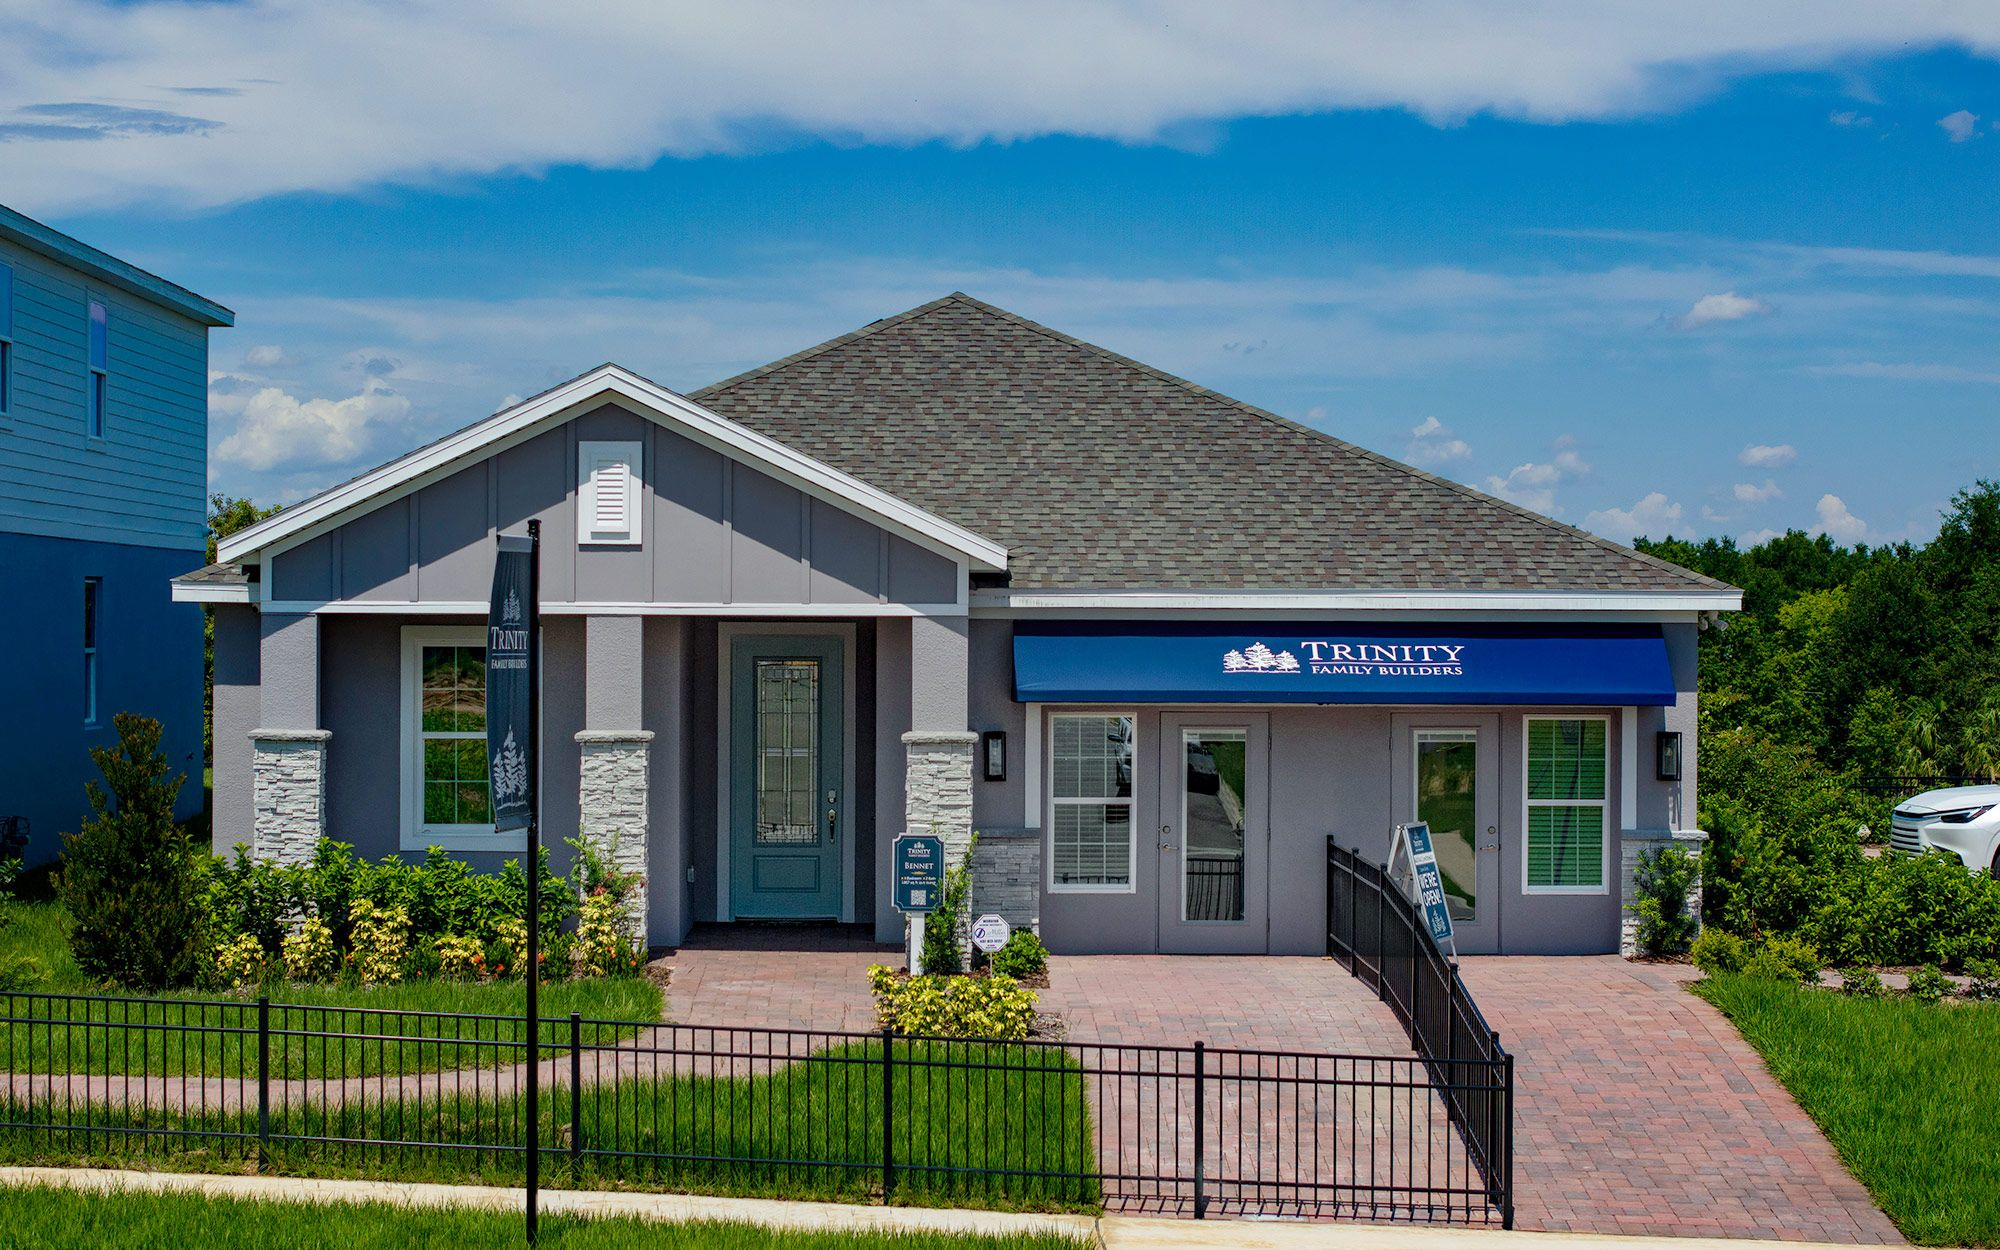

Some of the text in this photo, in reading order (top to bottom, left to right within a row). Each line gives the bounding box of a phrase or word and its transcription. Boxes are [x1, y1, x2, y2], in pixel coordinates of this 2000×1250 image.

[491, 627, 528, 649] TRINITY
[1301, 641, 1464, 661] TRINITY
[1312, 665, 1463, 675] FAMILY BUILDERS
[1423, 888, 1443, 907] OPEN!
